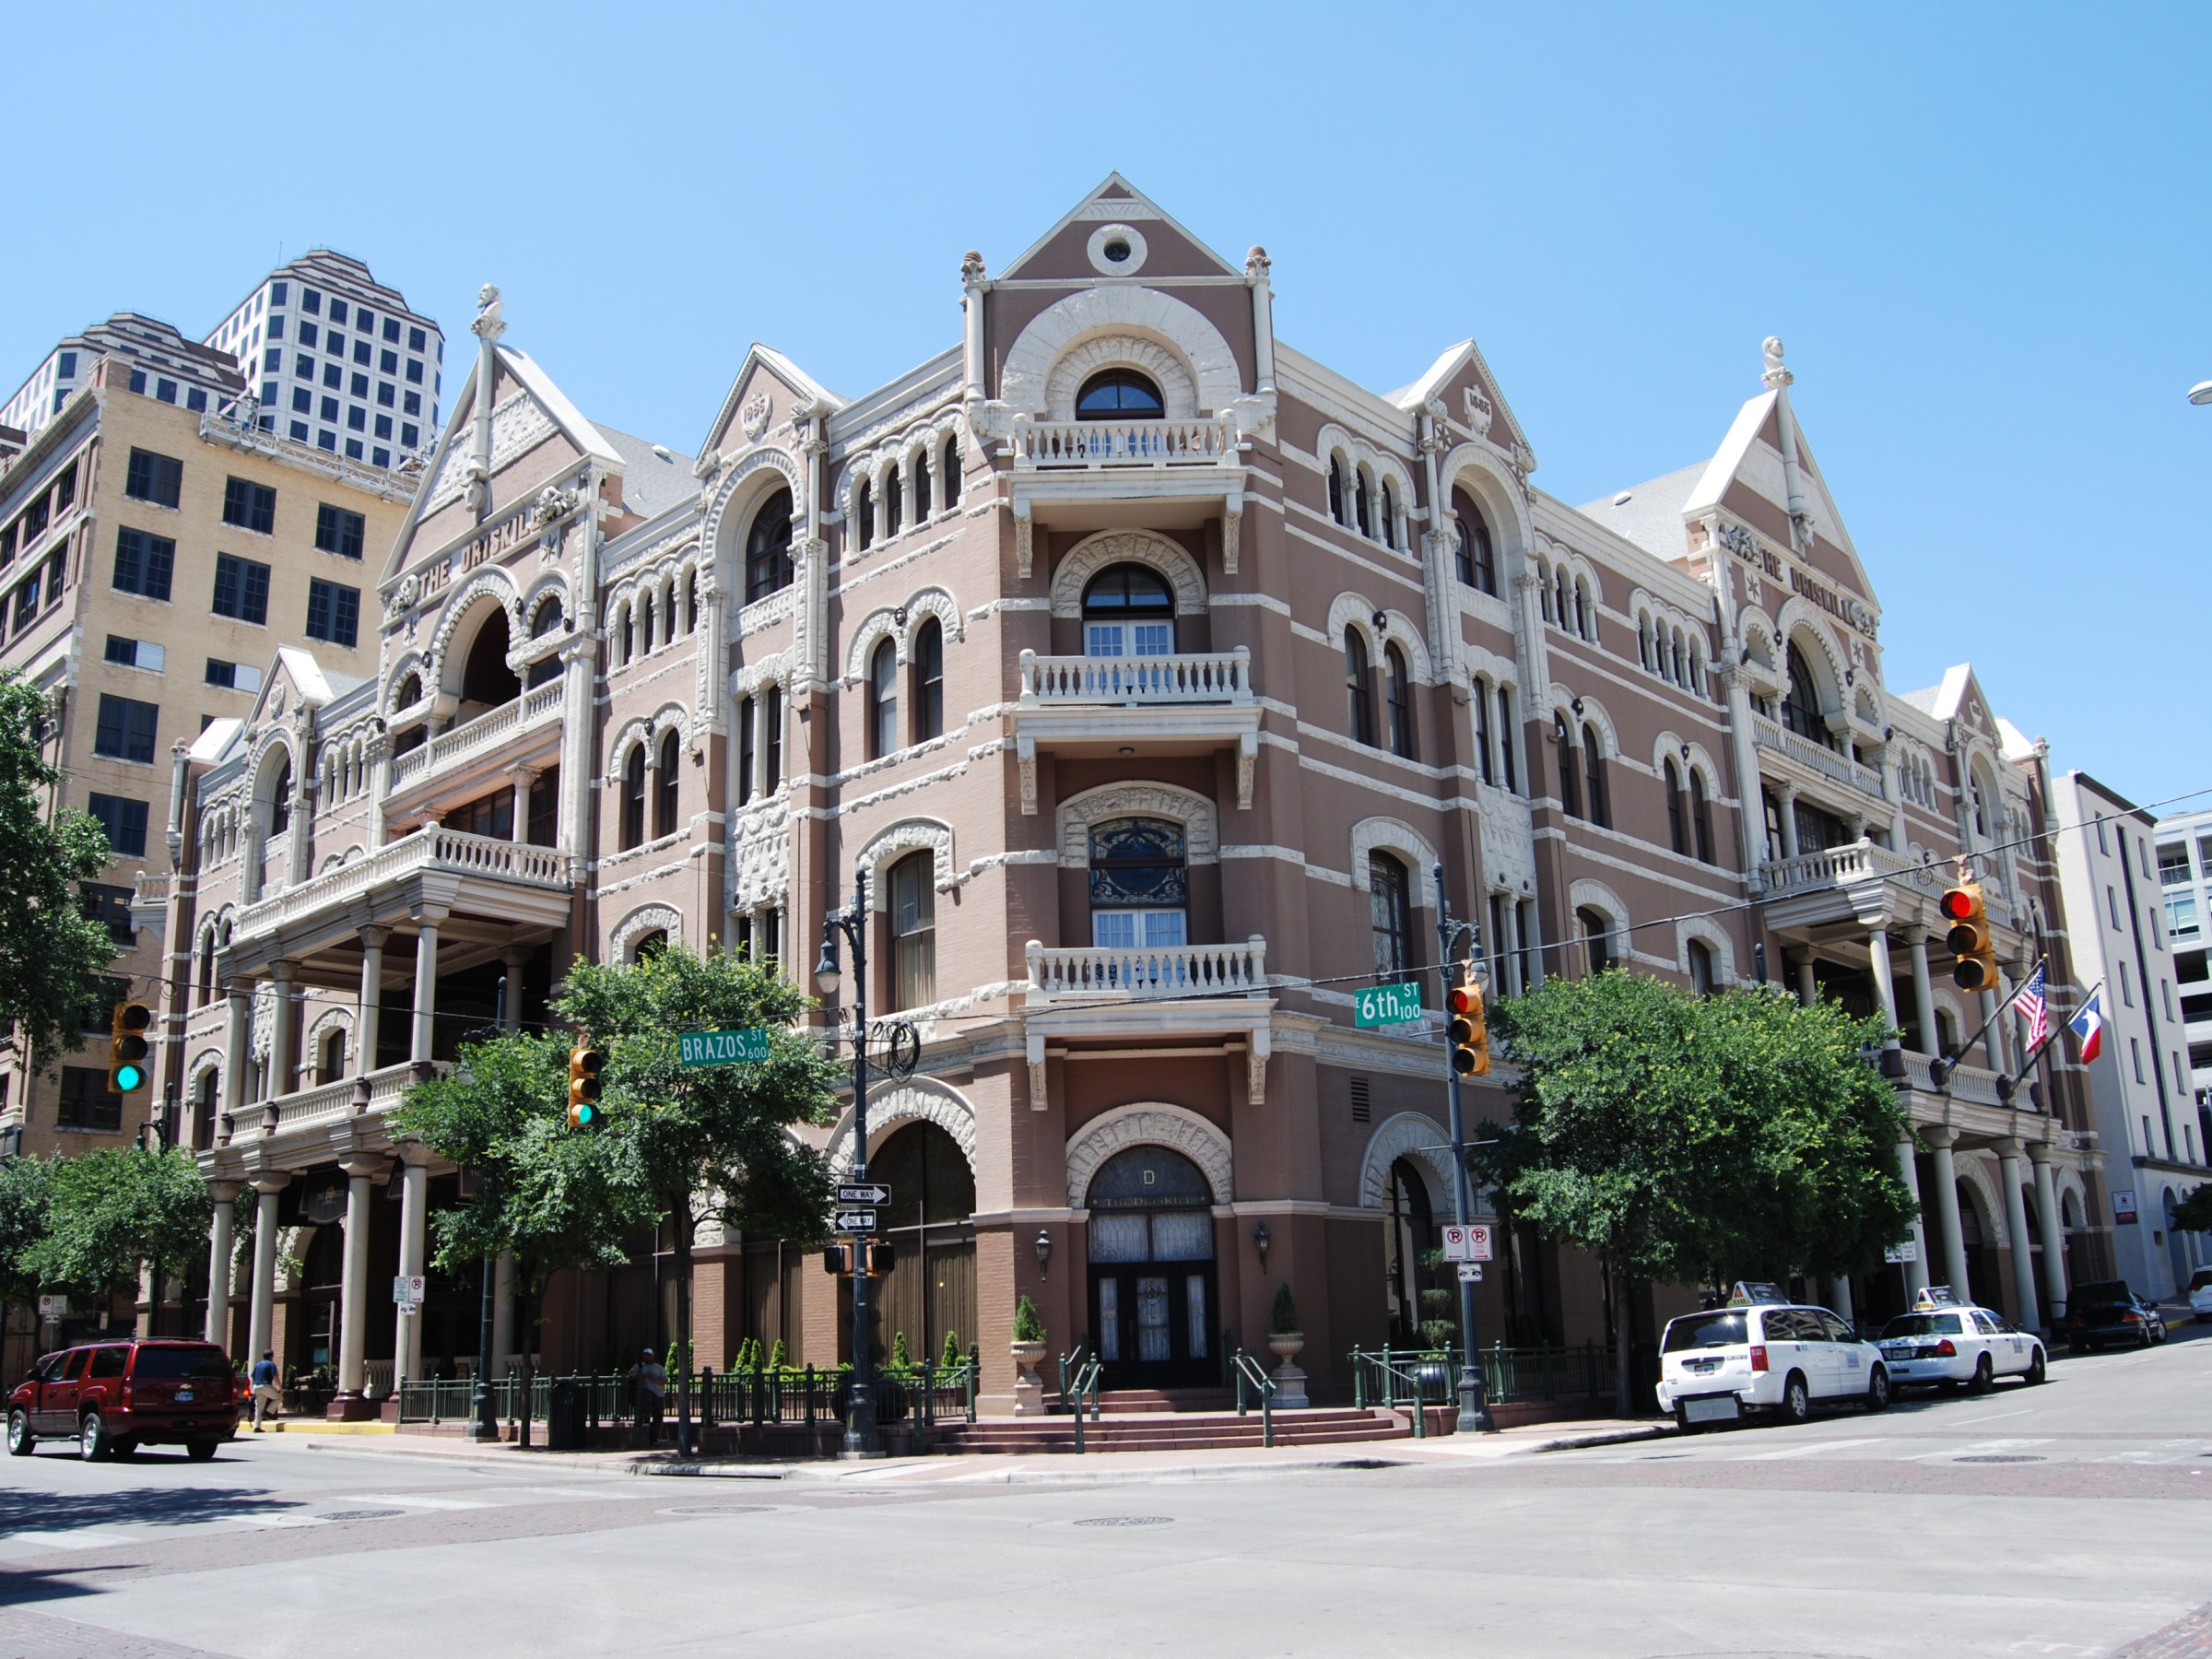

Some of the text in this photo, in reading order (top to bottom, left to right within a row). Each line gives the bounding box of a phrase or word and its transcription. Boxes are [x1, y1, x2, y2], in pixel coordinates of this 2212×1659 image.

[419, 506, 541, 598] THE DRISKILL
[1790, 567, 1853, 627] DRISKILL
[1404, 982, 1418, 997] ST
[1355, 991, 1421, 1019] E 6th 100
[751, 1030, 762, 1041] ST
[682, 1034, 767, 1061] BRAZOS 600
[1143, 1170, 1155, 1184] D
[842, 1190, 857, 1198] ONE
[1106, 1196, 1193, 1206] THE DRISKILL
[847, 1217, 871, 1226] ONE WAY
